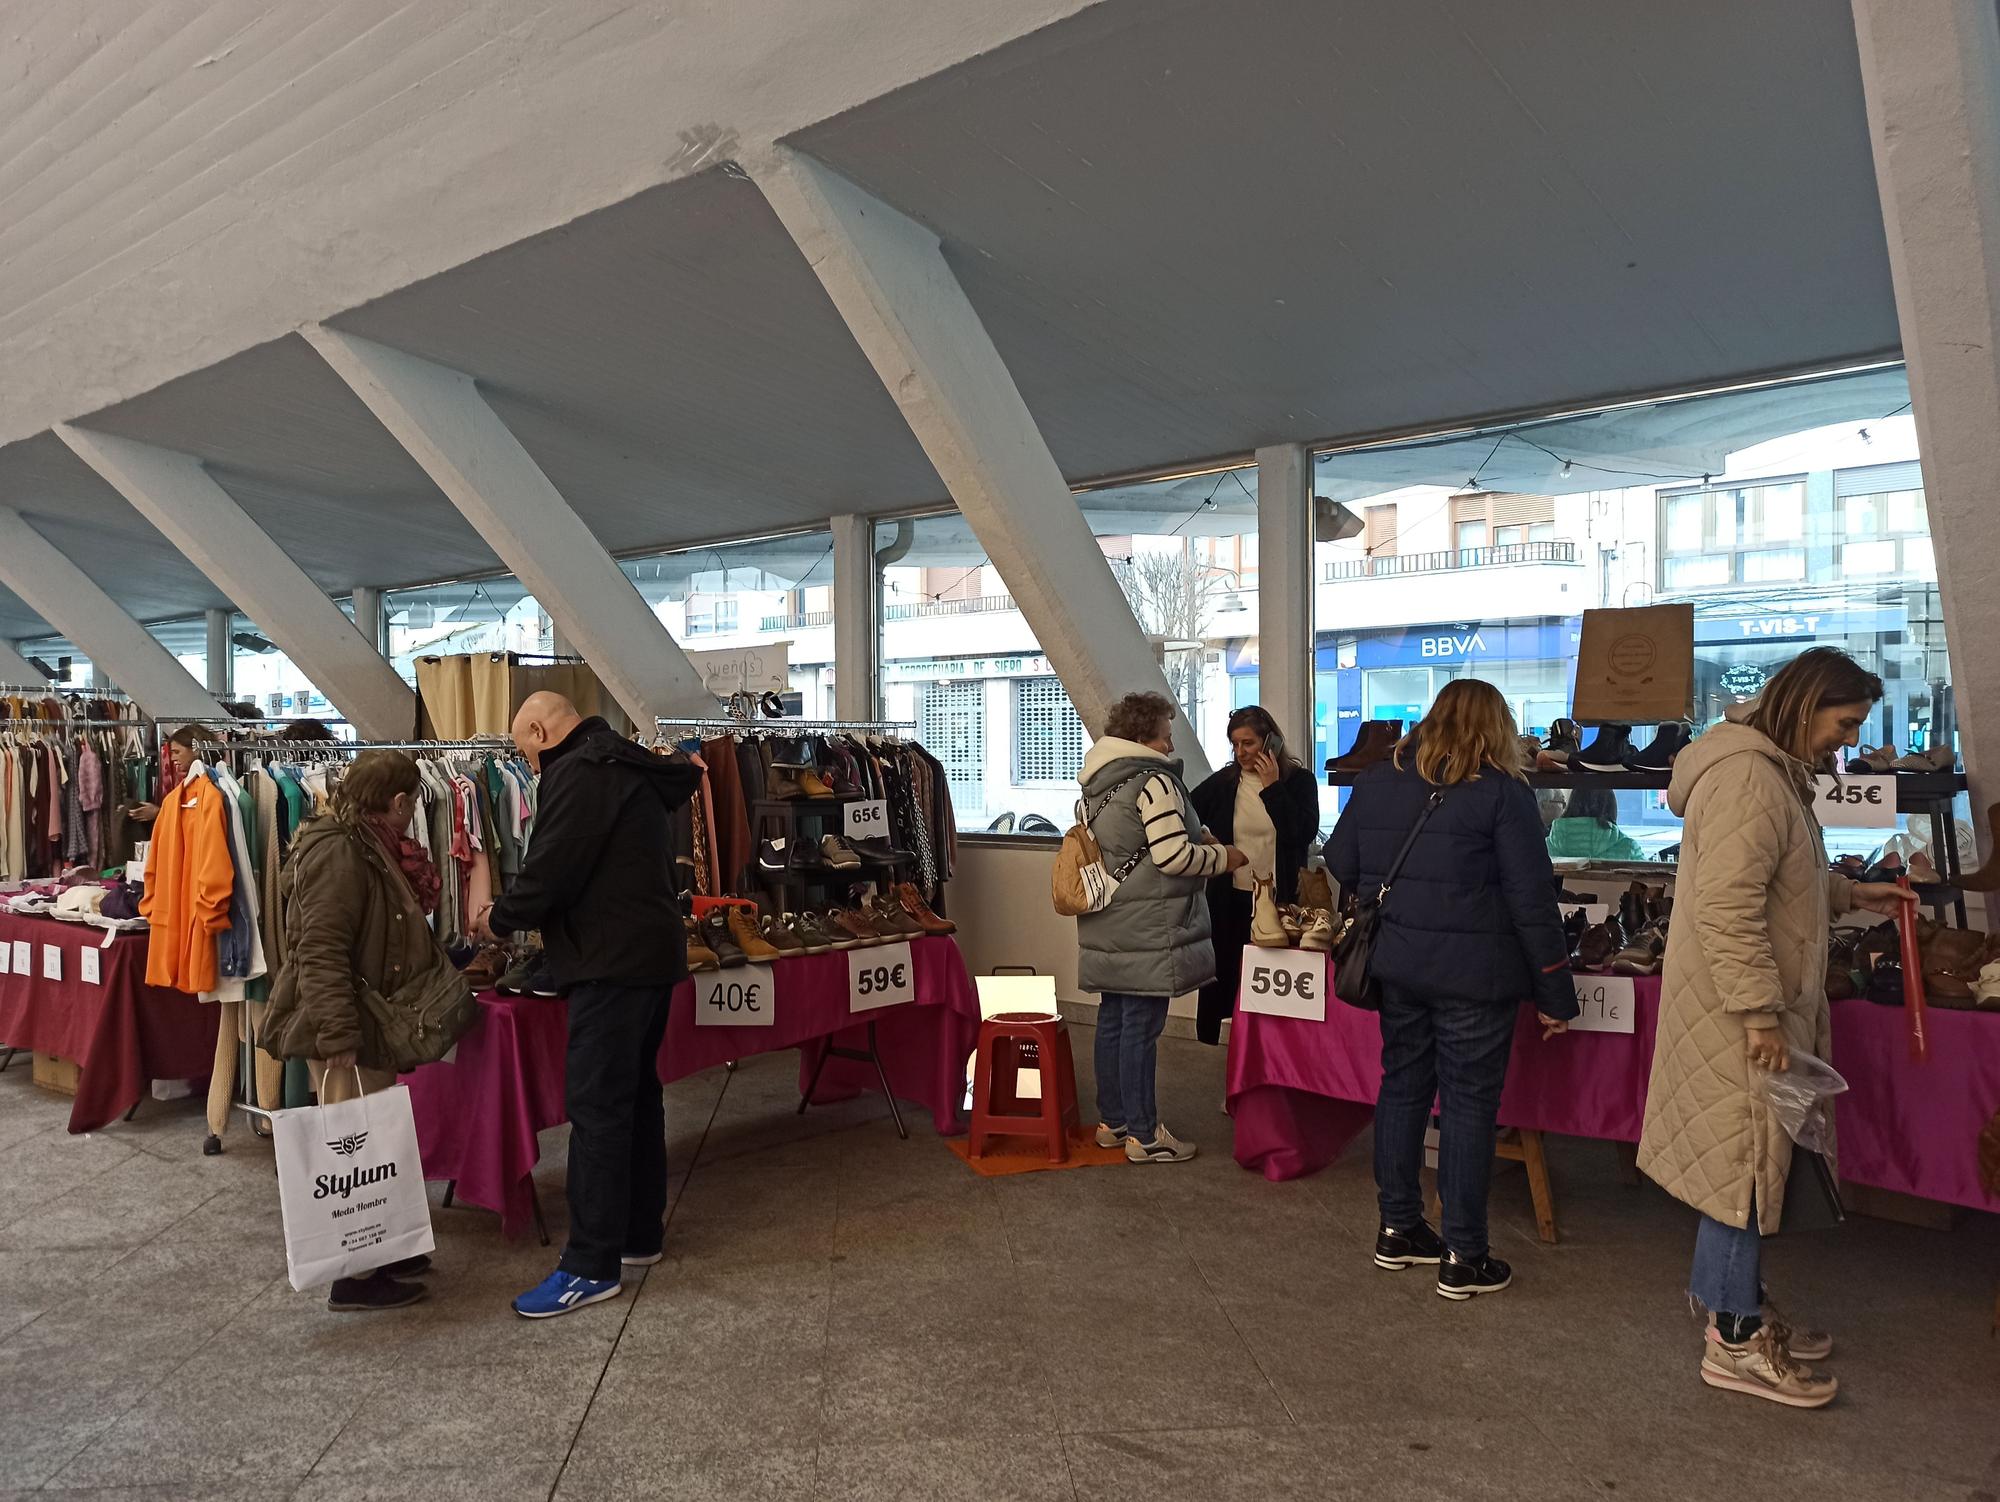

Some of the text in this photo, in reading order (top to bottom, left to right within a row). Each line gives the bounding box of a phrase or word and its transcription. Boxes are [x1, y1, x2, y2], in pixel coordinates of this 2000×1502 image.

[1739, 617, 1819, 636] T-VIS-T
[1421, 633, 1486, 657] BBVA
[973, 661, 985, 675] DE
[994, 659, 1022, 673] SIERO
[1338, 710, 1360, 719] BBVA
[1825, 785, 1882, 804] 45€
[852, 806, 881, 823] 65€
[858, 963, 907, 995] 59€
[1251, 966, 1315, 1000] 59€
[708, 982, 761, 1012] 40€
[313, 1162, 398, 1199] Stylum
[331, 1197, 388, 1219] Moda Hombre
